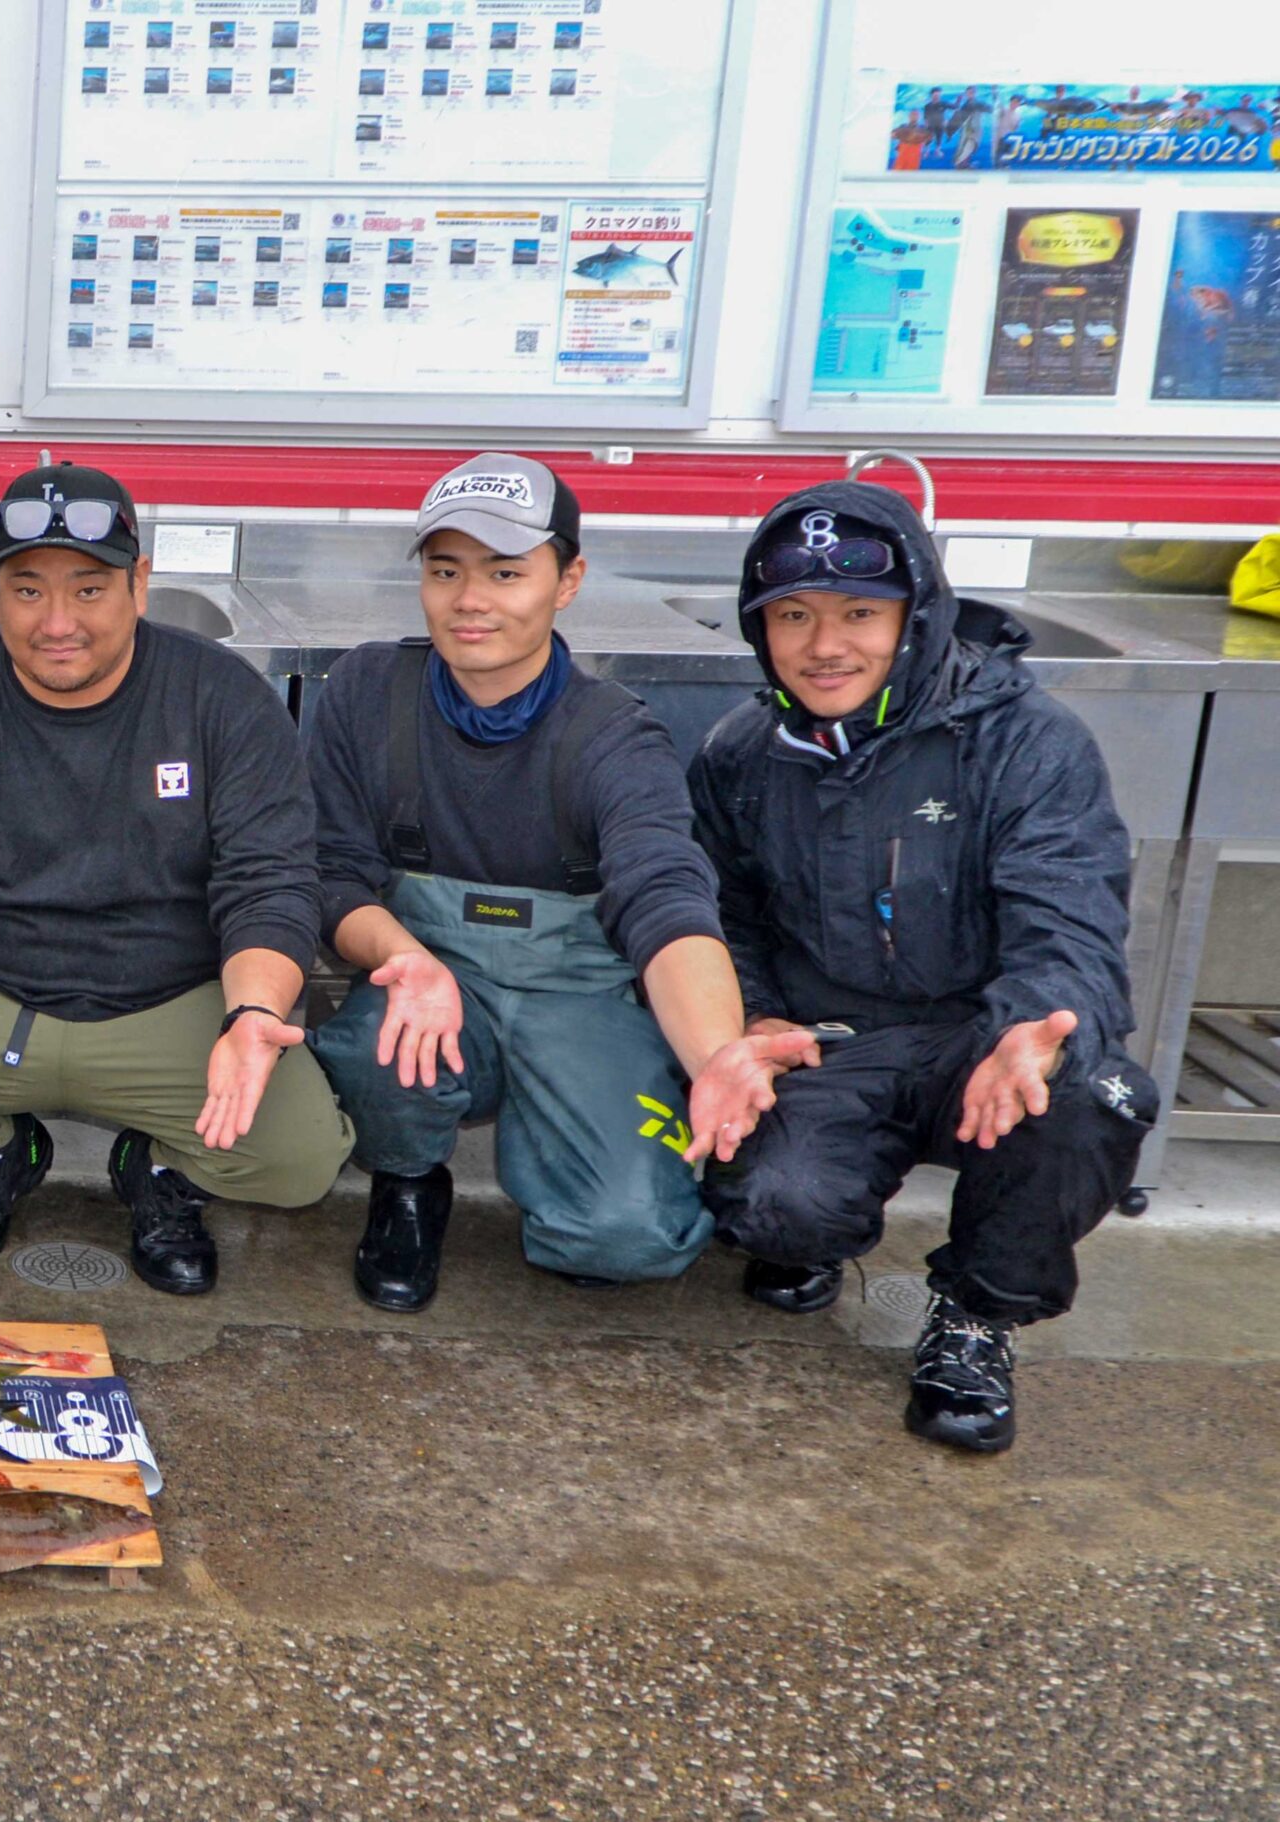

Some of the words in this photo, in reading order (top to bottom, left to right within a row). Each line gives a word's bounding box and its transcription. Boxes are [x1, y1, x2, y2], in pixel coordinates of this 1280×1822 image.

[585, 215, 681, 229] クロマグロ釣り
[428, 478, 504, 507] Jackson
[54, 1408, 124, 1460] 8
